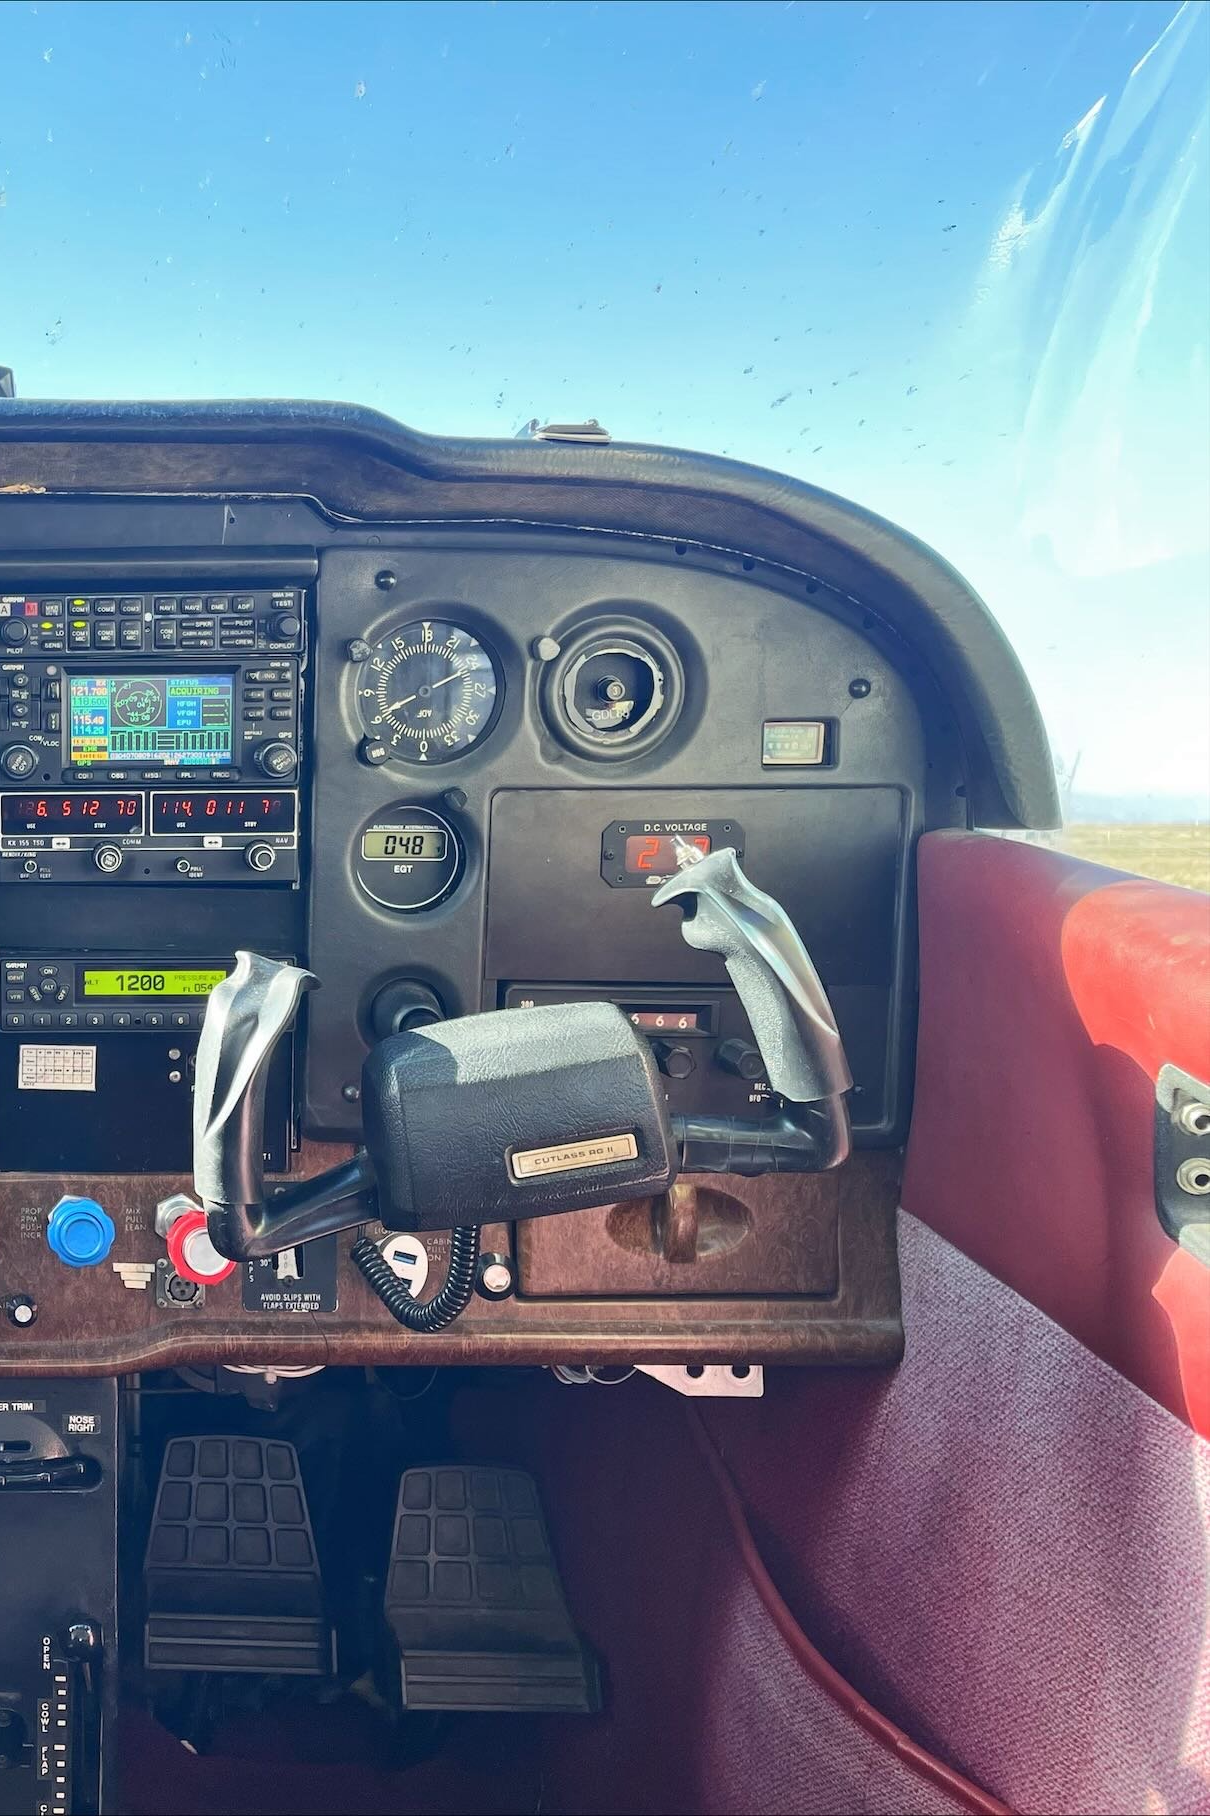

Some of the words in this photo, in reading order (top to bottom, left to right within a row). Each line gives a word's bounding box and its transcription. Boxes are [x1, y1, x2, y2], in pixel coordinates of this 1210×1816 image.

[170, 687, 219, 695] ACQUIRING
[74, 715, 104, 725] 115.40
[644, 824, 663, 832] D.C.
[665, 823, 708, 832] VOLTAGE
[384, 835, 424, 855] 048
[393, 865, 413, 874] EGT
[115, 975, 165, 991] 1200
[65, 1017, 72, 1025] 2
[92, 1017, 98, 1025] 3
[118, 1017, 124, 1025] 4
[151, 1017, 157, 1025] 5
[178, 1017, 184, 1025] 6
[534, 1151, 586, 1166] CUTLASS
[589, 1147, 606, 1156] RG
[20, 1207, 42, 1215] PROP
[304, 1293, 321, 1301] WITH
[263, 1302, 284, 1310] FLAPS
[286, 1302, 320, 1310] EXTENDED
[12, 1402, 33, 1411] TRIM
[69, 1416, 94, 1424] NOSE
[67, 1423, 95, 1432] RIGHT
[42, 1637, 51, 1671] OPEN
[41, 1703, 50, 1733] COWL
[41, 1746, 49, 1776] FLAP
